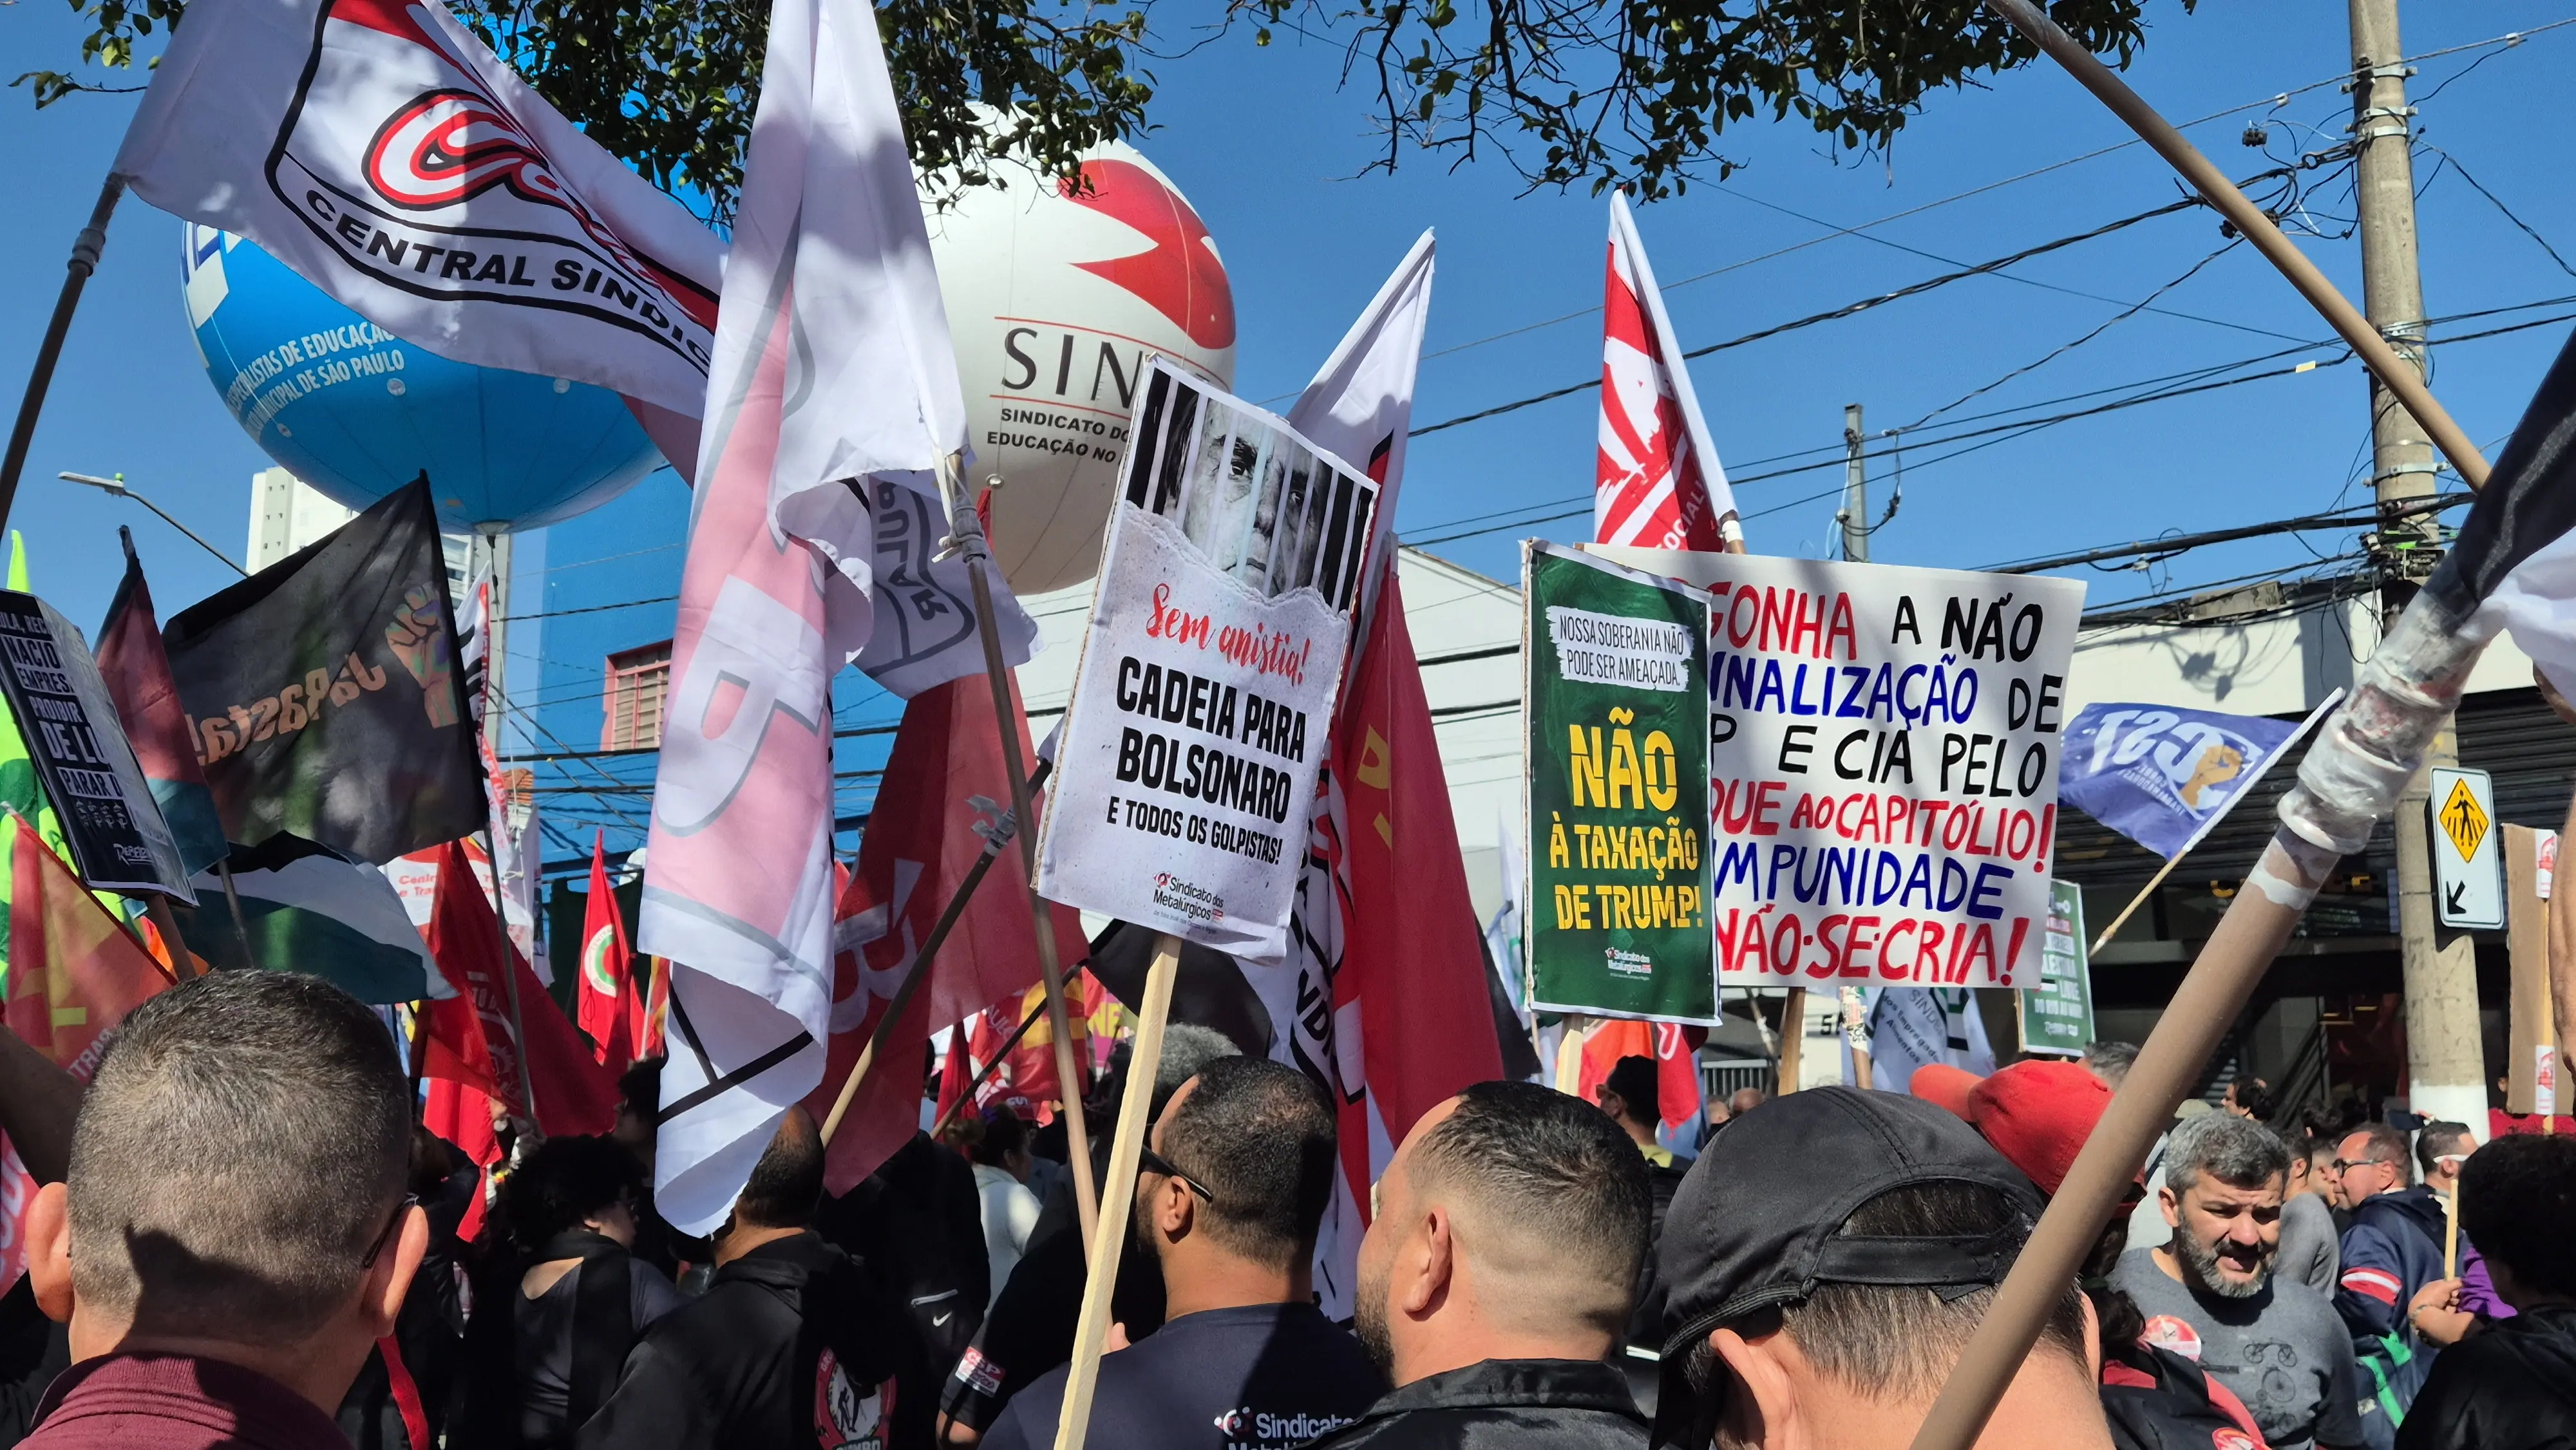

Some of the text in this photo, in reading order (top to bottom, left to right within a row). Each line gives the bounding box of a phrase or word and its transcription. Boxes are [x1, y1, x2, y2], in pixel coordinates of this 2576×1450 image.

[306, 191, 535, 287] CENTRAL
[278, 340, 304, 367] DE
[296, 369, 321, 393] DE
[317, 359, 351, 386] SÃO
[350, 349, 404, 378] PAULO
[1001, 408, 1105, 436] SINDICATO
[987, 431, 1117, 463] EDUCAÇÃO NO
[26, 616, 50, 635] REC
[1146, 583, 1311, 687] Sem anistia!
[1560, 614, 1684, 655] NOSSA SOBERANIA NÃO
[1891, 596, 1922, 645] A
[1940, 592, 2043, 663] NÃO
[17, 668, 74, 693] EMPRES
[1567, 649, 1681, 691] PODE SER AMEAÇADA.
[28, 695, 84, 722] PROIBIR
[1116, 655, 1307, 763] CADEIA PARA
[2008, 673, 2063, 733] DE
[39, 720, 78, 761] DE
[1569, 706, 1678, 812] NÃO
[1778, 725, 1818, 774] E
[1834, 729, 1913, 784] CIA
[1940, 733, 2047, 798] PELO
[61, 769, 110, 796] PARAR
[1116, 726, 1291, 824] BOLSONARO
[1106, 796, 1283, 865] E TODOS OS GOLPISTAS!
[1549, 811, 1698, 881] À TAXAÇÃO
[1153, 889, 1211, 921] Metalúrgicos
[1170, 877, 1224, 908] Sindicato dos
[1555, 885, 1703, 930] DE TRUMP!
